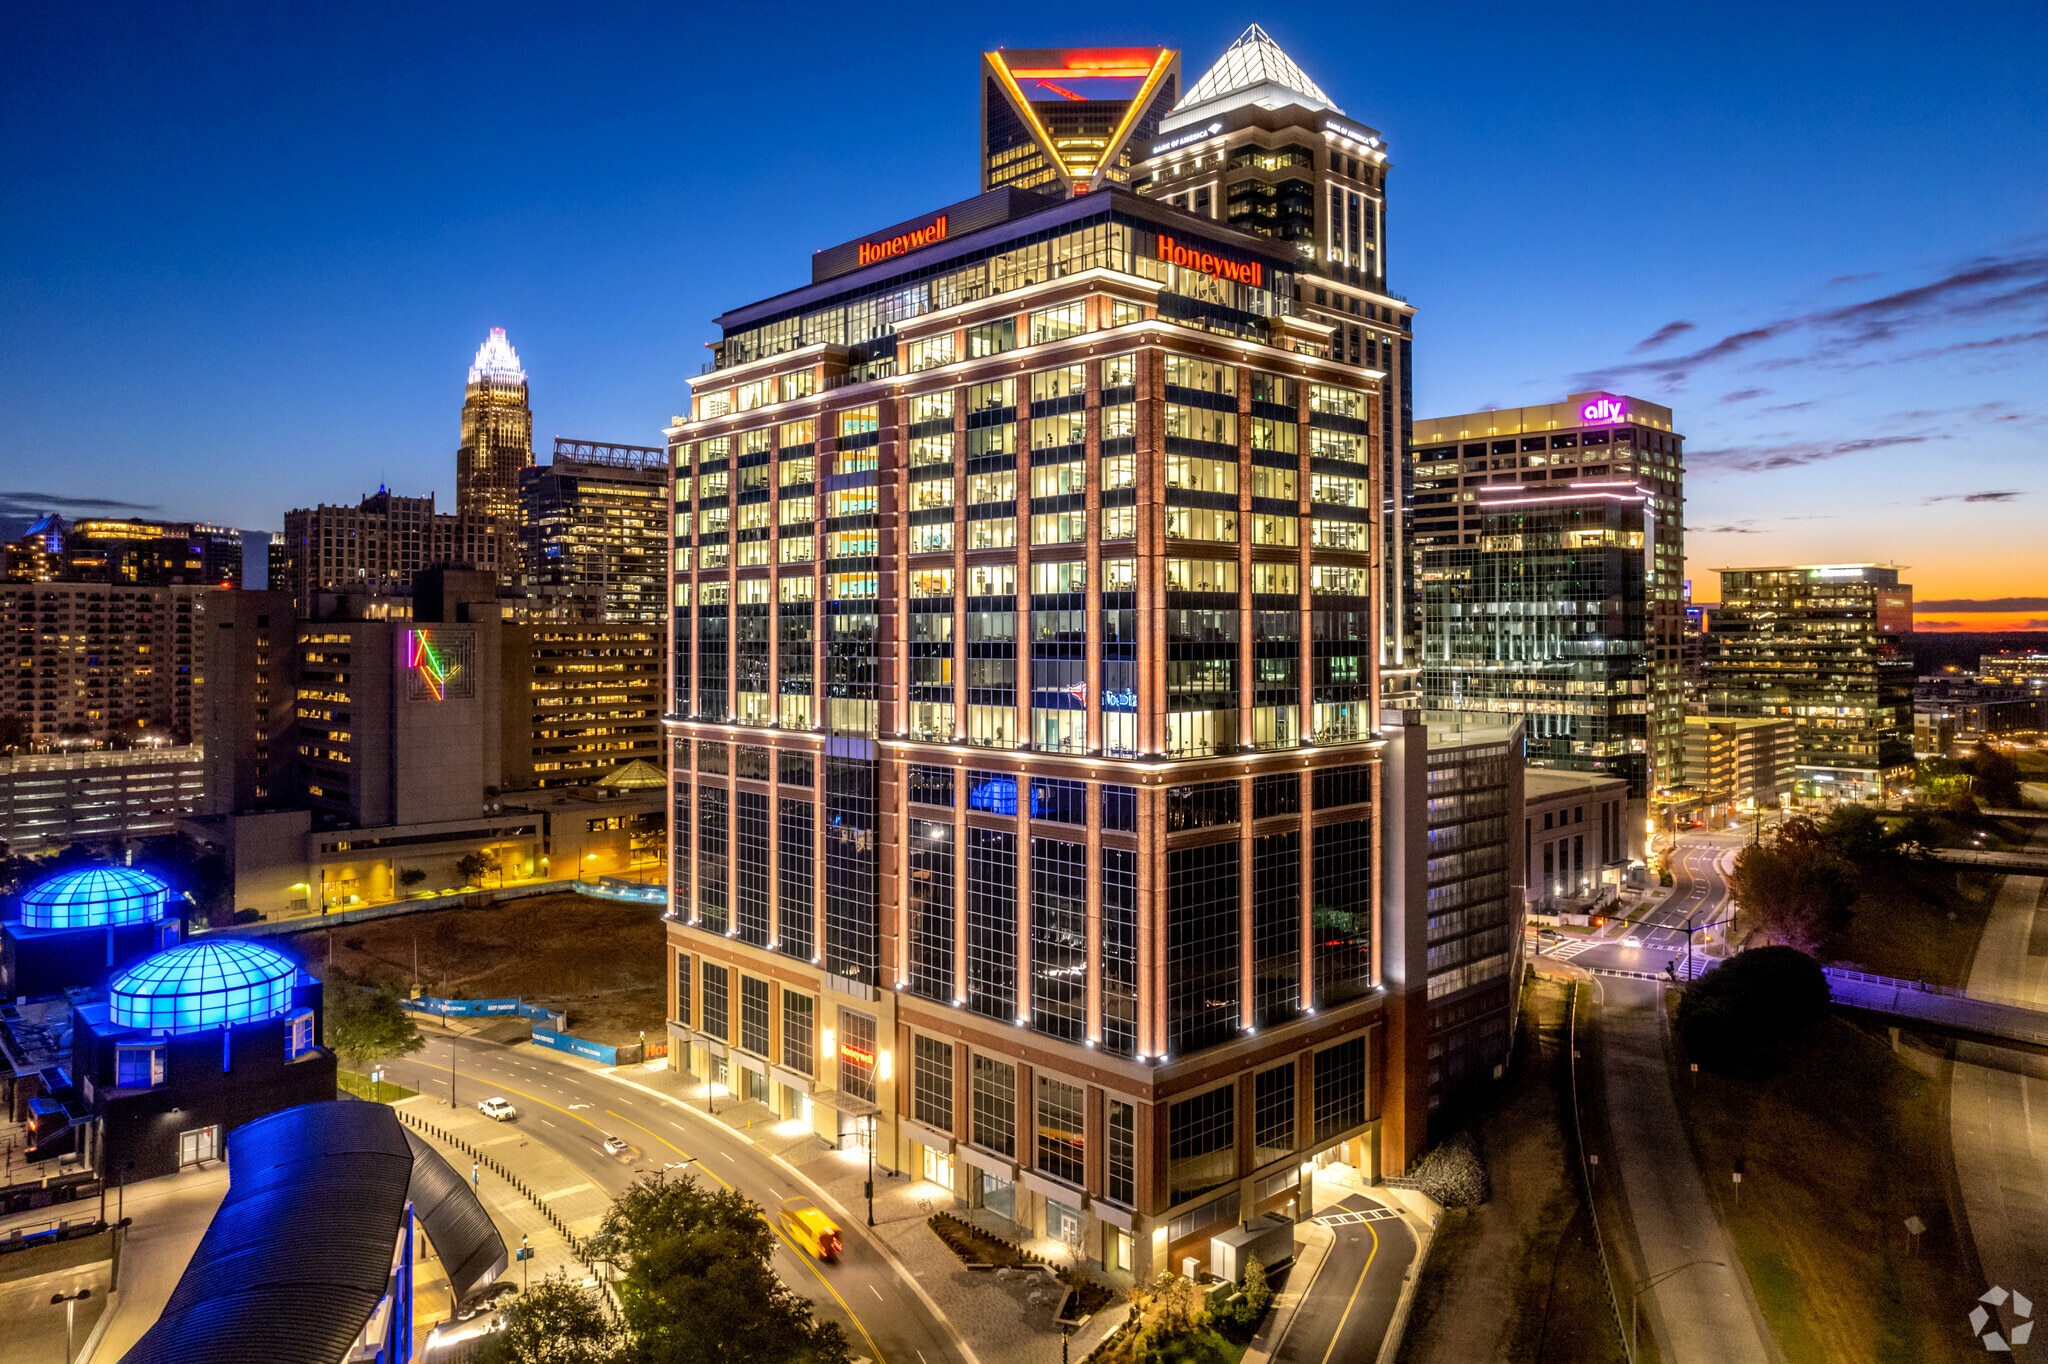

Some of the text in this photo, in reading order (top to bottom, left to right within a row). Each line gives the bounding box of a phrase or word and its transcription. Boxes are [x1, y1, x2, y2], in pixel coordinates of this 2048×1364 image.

[1153, 129, 1208, 154] BANK OF AMERICA
[858, 216, 948, 266] Honeywell
[1157, 234, 1263, 287] Honeywell
[1585, 400, 1622, 422] ally
[841, 1044, 874, 1065] Honeywell
